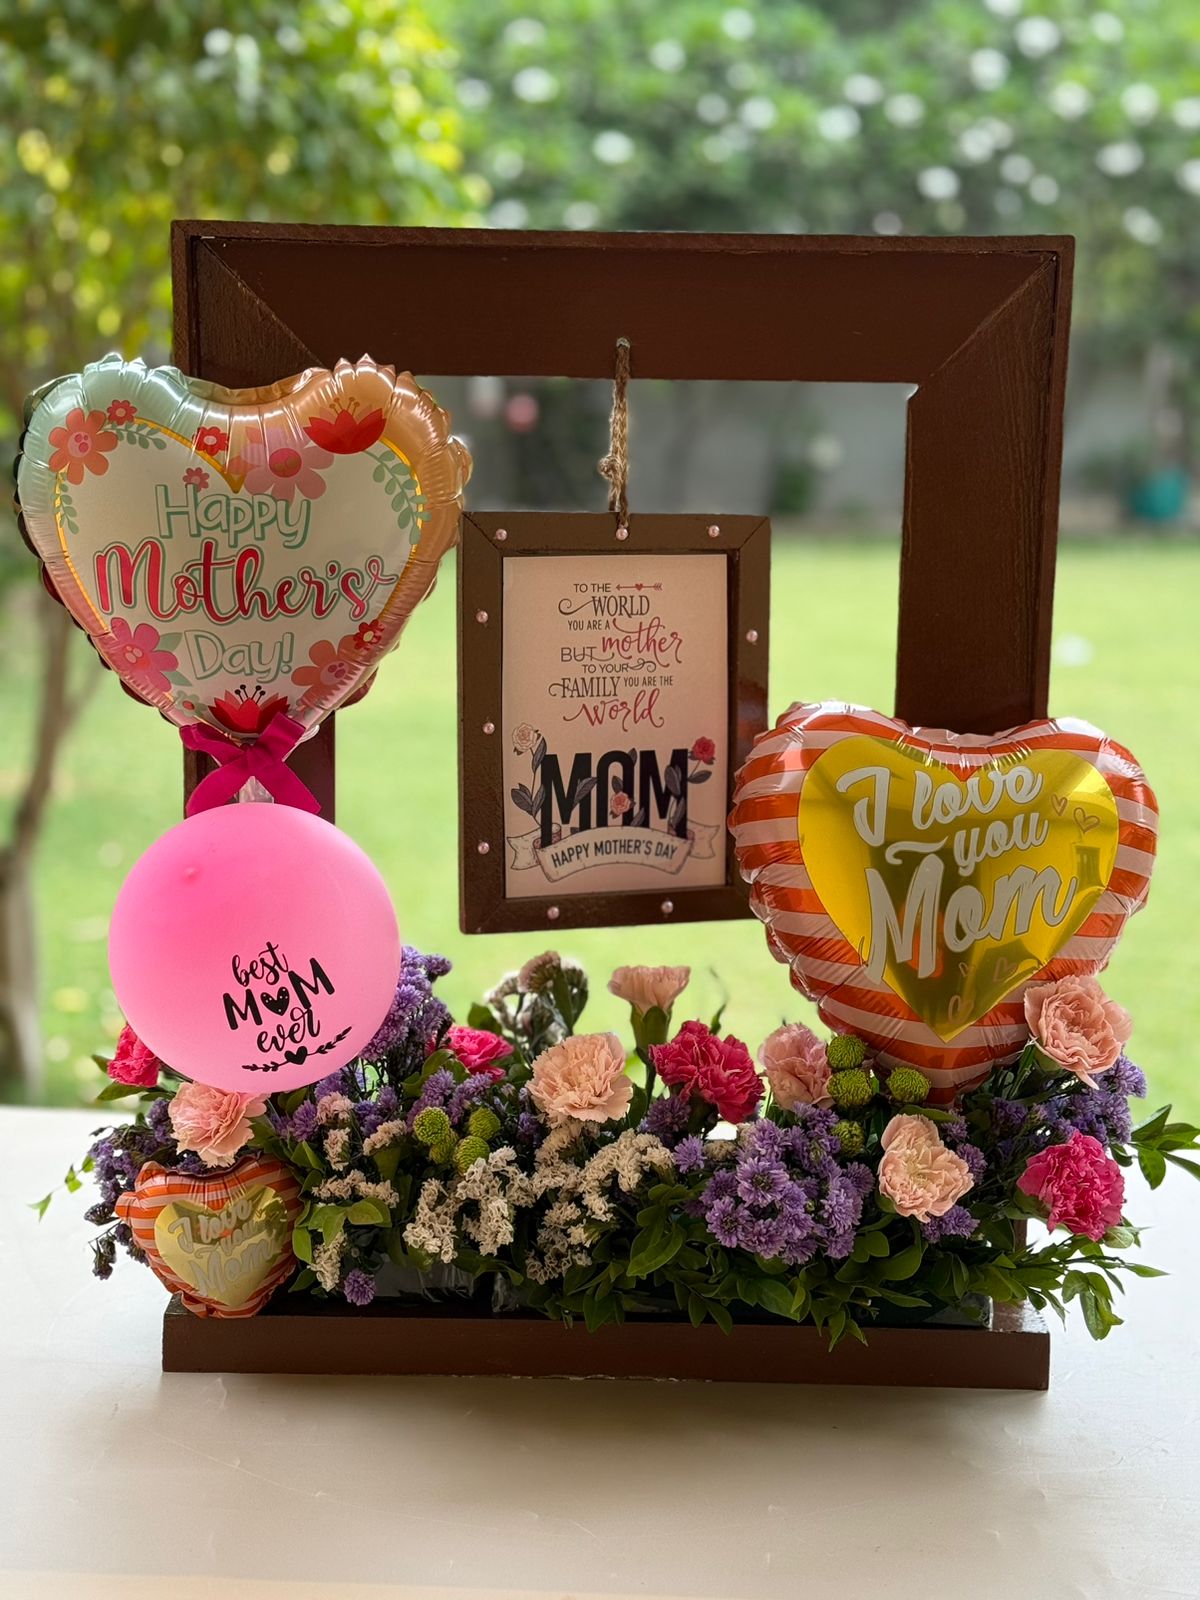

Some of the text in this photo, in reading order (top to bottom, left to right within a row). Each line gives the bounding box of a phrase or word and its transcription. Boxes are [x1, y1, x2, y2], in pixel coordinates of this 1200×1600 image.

[155, 484, 311, 547] Happy
[94, 540, 400, 622] Mother's
[573, 583, 612, 593] TO THE
[558, 595, 650, 618] WORLD
[183, 629, 294, 683] Day!
[560, 647, 614, 662] BUT
[568, 616, 683, 668] YOU ARE A mother
[548, 676, 673, 698] FAMILY YOU ARE THE
[582, 664, 596, 674] TO
[541, 749, 689, 849] MOM
[836, 765, 1043, 847] I love
[551, 839, 679, 868] HAPPY MOTHER'S DAY
[953, 812, 1049, 876] you
[864, 853, 1077, 985] Mom
[232, 941, 289, 987] best
[256, 1006, 321, 1053] ever
[198, 1200, 251, 1244] love
[188, 1229, 277, 1297] Mom
